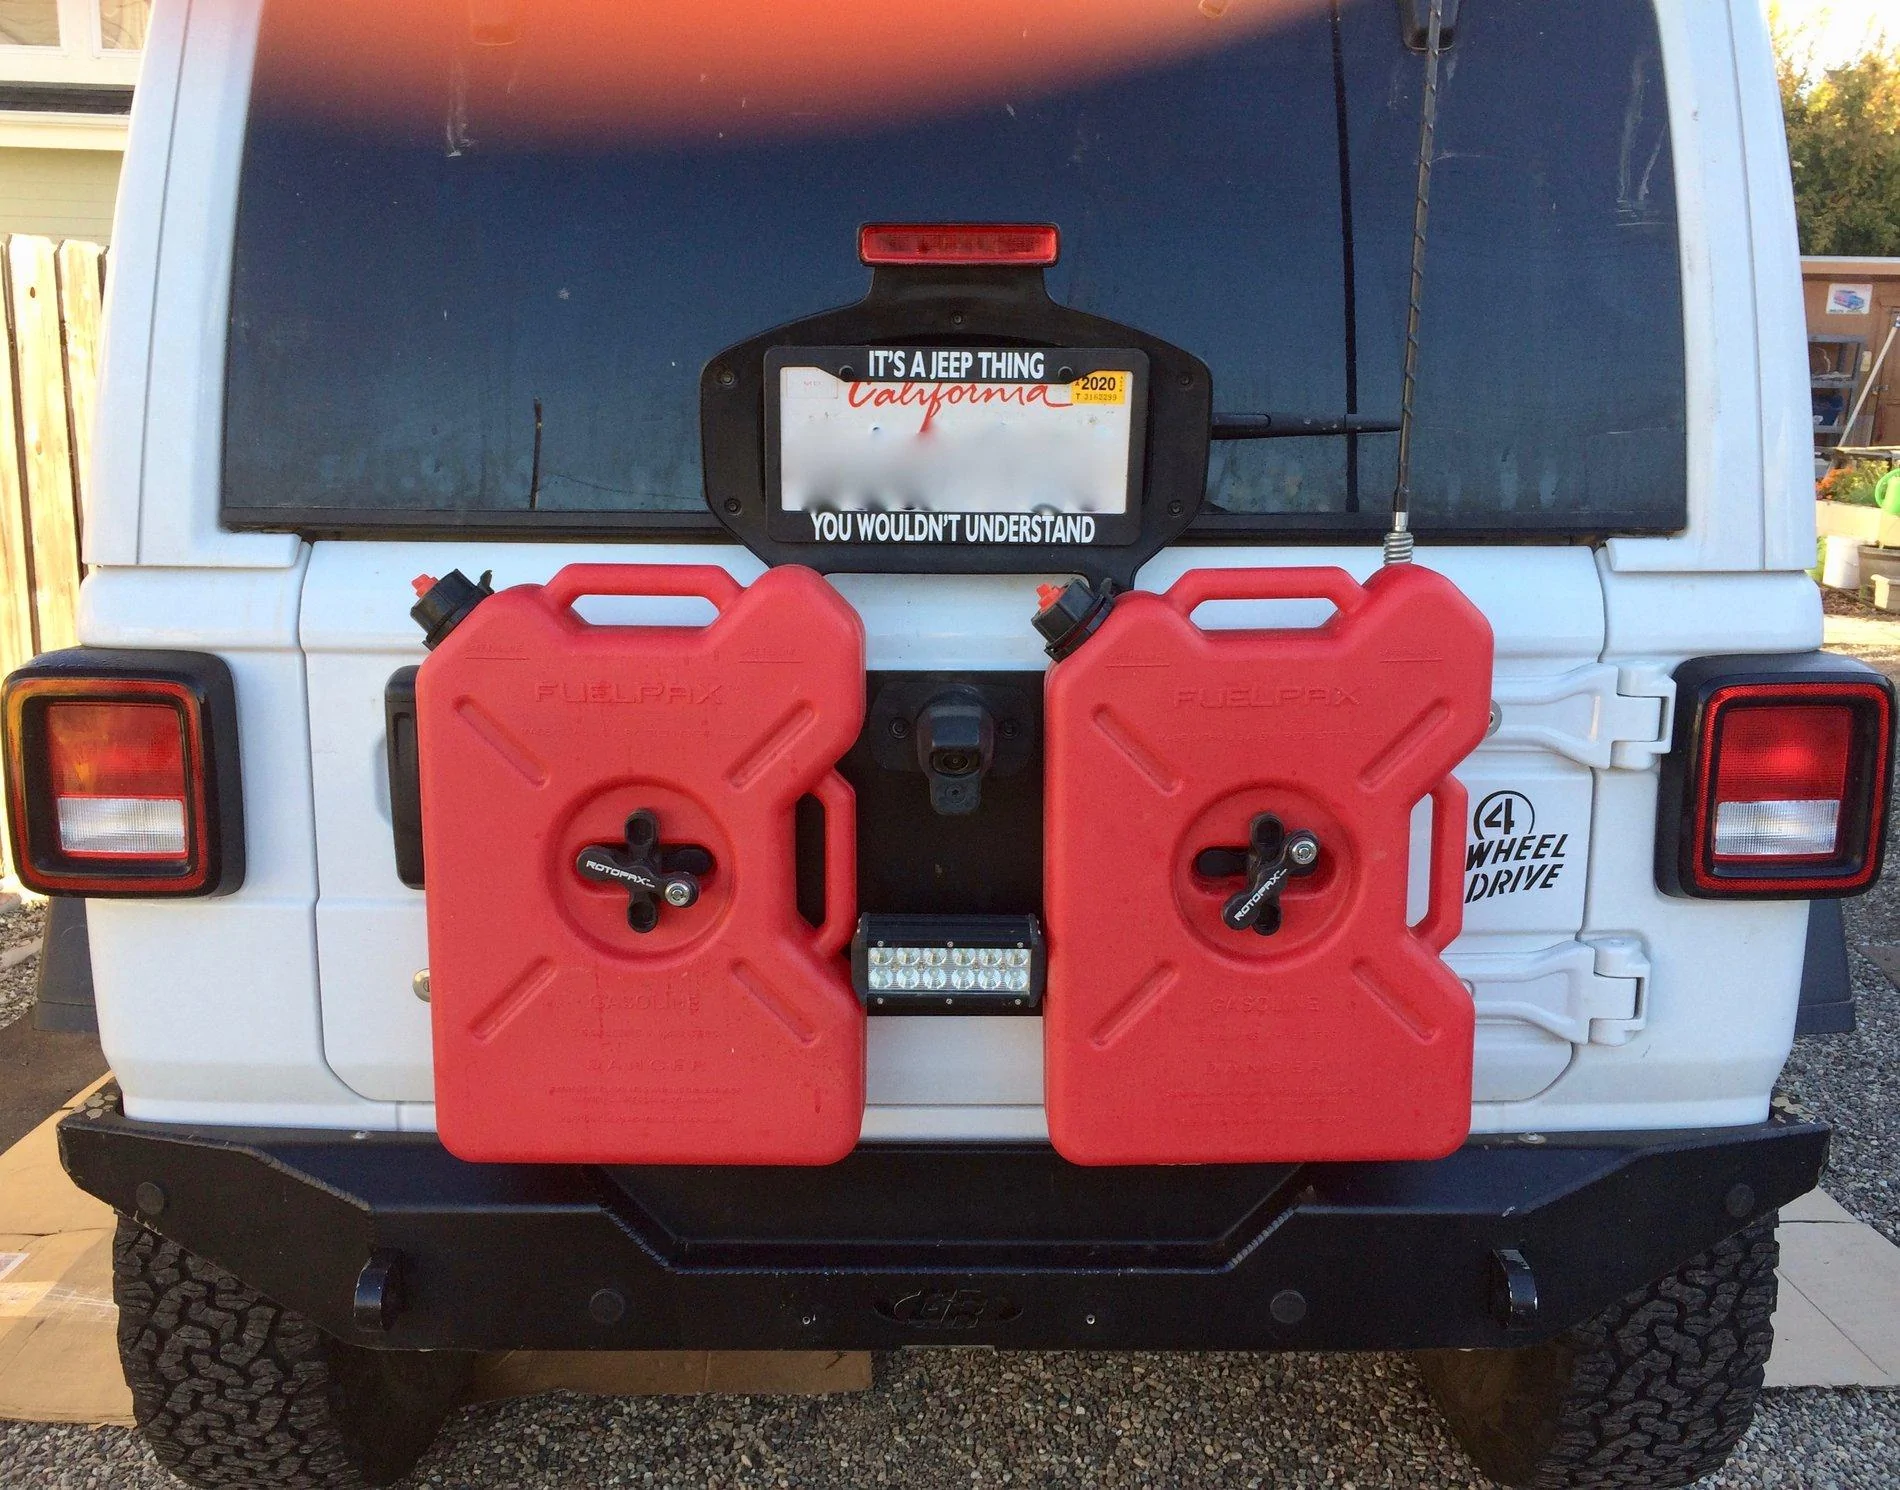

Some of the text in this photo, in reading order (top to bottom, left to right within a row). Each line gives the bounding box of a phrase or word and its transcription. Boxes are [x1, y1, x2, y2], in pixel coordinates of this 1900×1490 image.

[868, 350, 1045, 380] IT'S A JEEP THING
[1081, 376, 1116, 391] 2020
[847, 381, 1073, 432] California
[810, 511, 1096, 544] YOU WOULDN'T UNDERSTAND
[535, 681, 723, 704] FUELPAX
[1174, 686, 1360, 709] FUELPAX
[1483, 798, 1515, 835] 4
[1465, 833, 1569, 872] WHEEL
[586, 860, 655, 888] ROTOPAX
[1464, 863, 1564, 904] DRIVE
[1234, 868, 1287, 921] ROTOPAX
